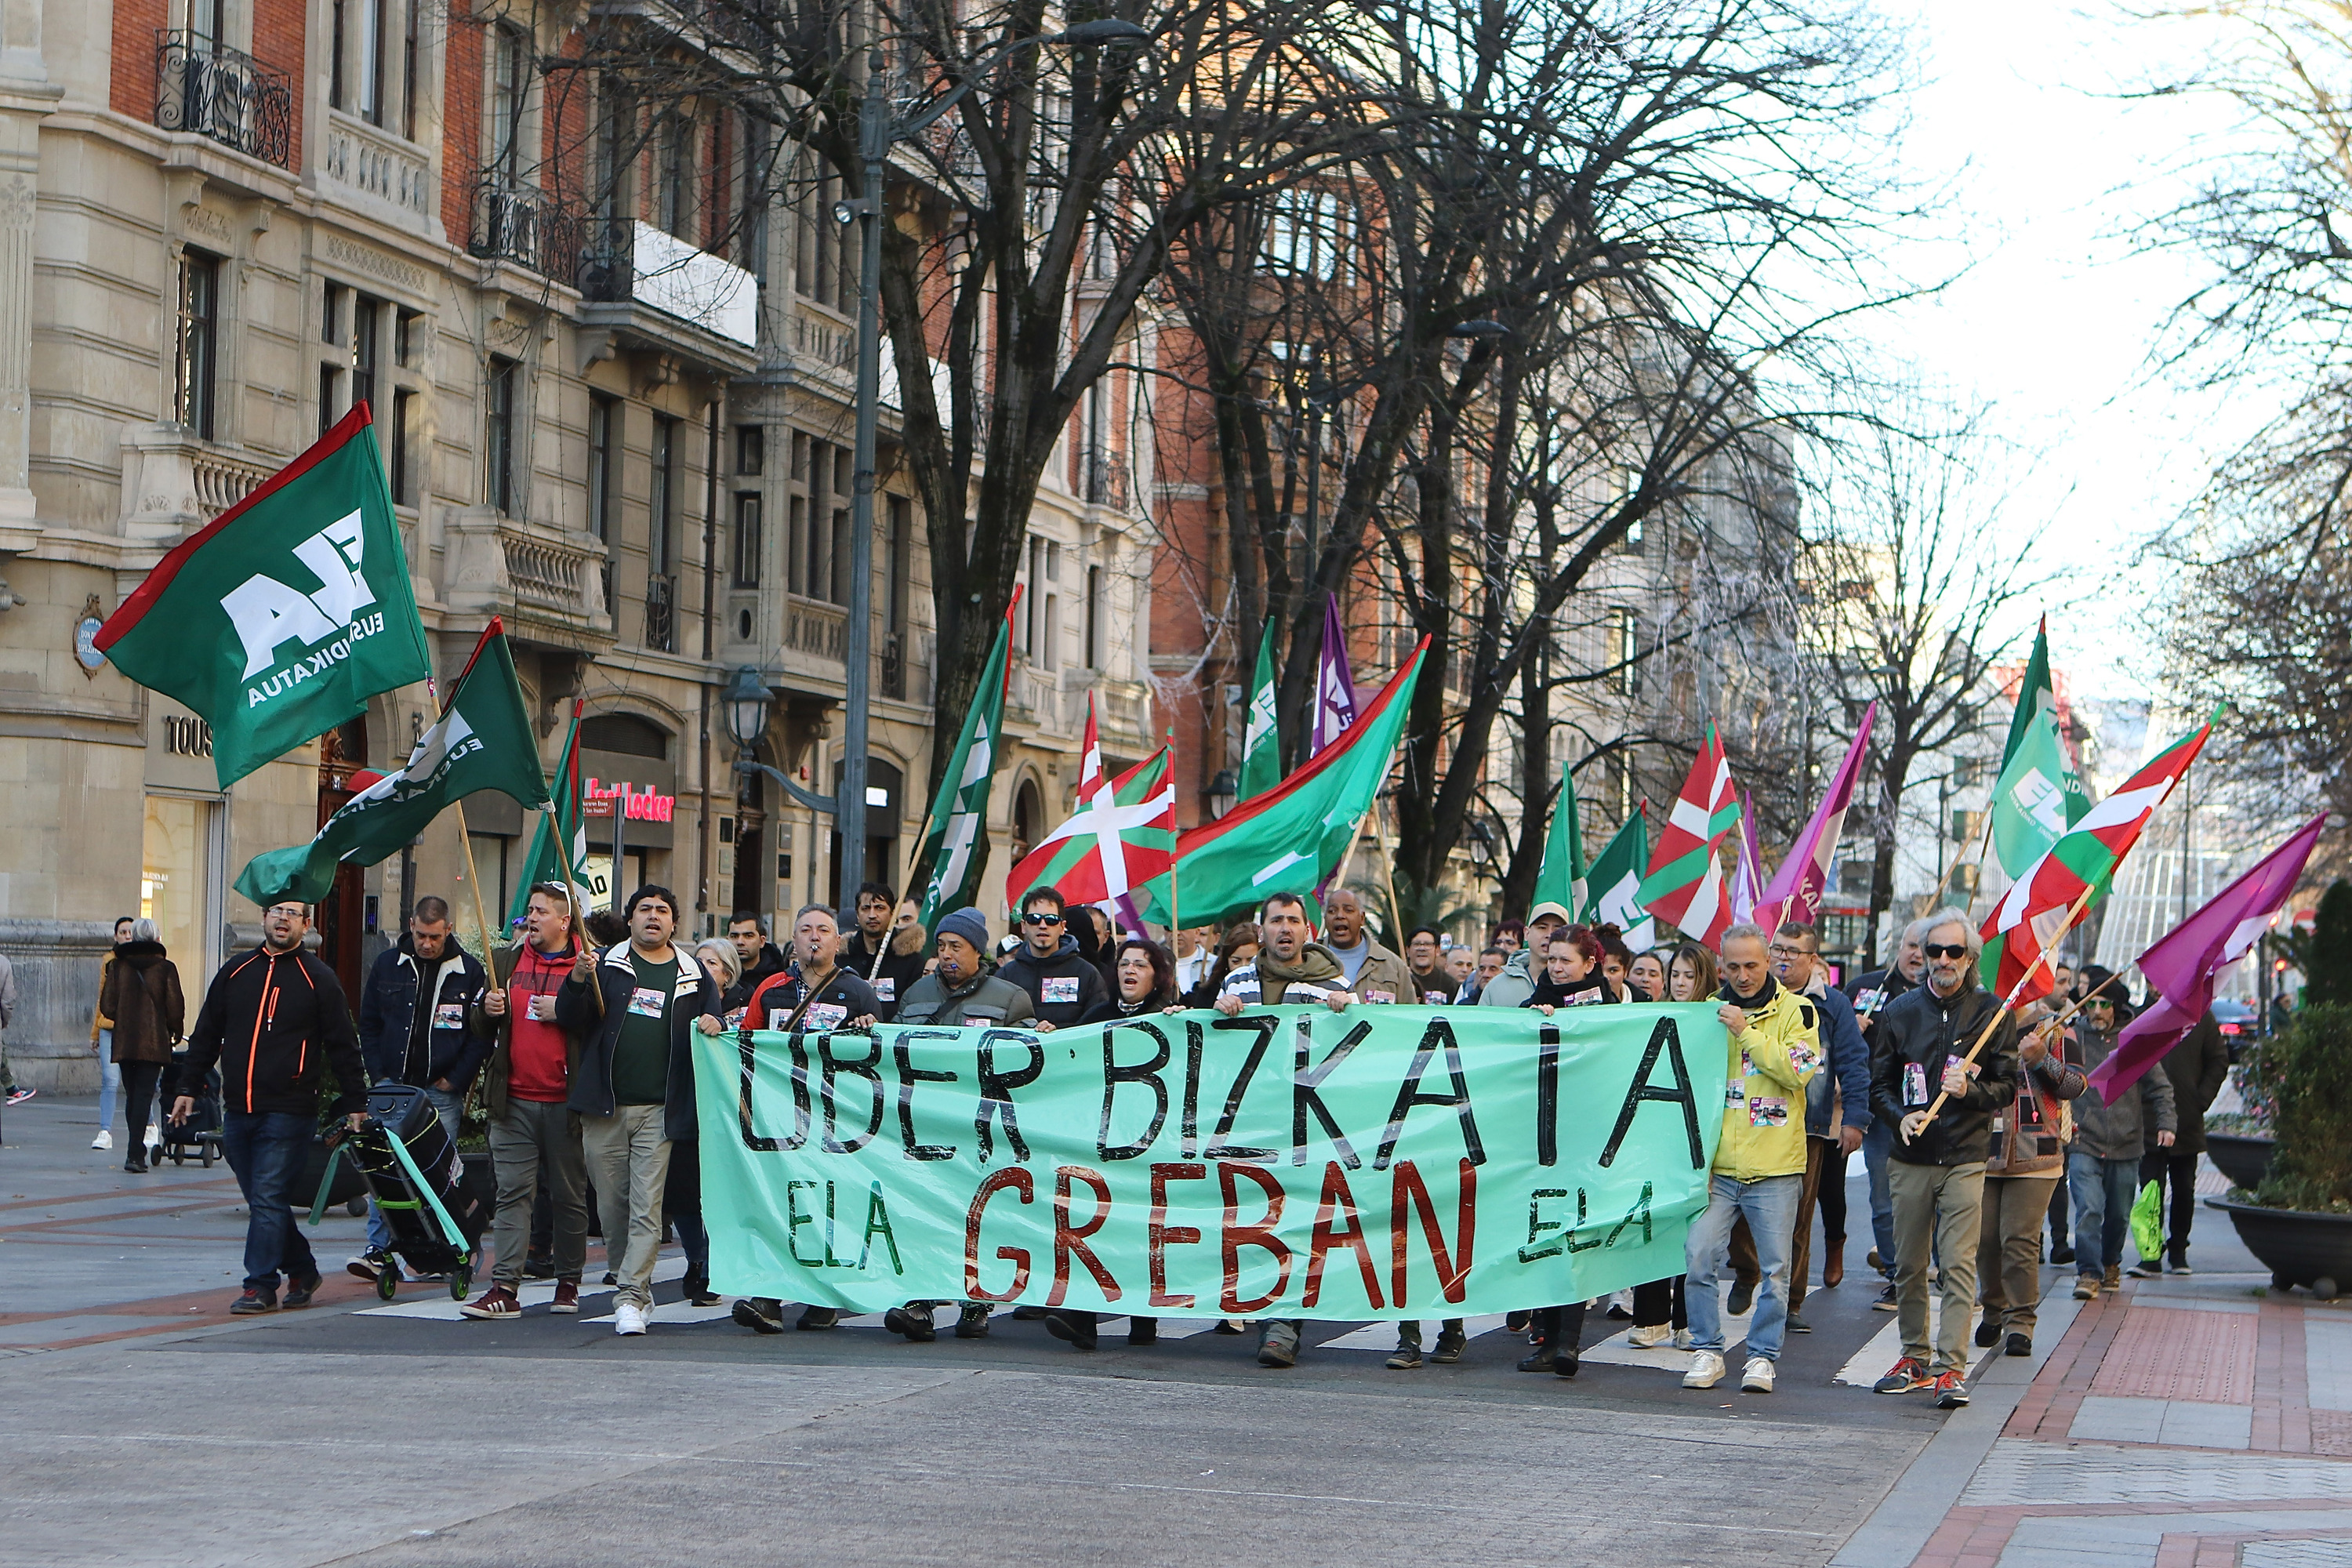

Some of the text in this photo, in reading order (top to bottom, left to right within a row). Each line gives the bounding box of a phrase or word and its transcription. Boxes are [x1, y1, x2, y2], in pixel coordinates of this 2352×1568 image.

[624, 782, 674, 822] Locker
[738, 1014, 1706, 1170] UBER BIZKAIA
[786, 1157, 1654, 1315] ELA GREBAN ELA
